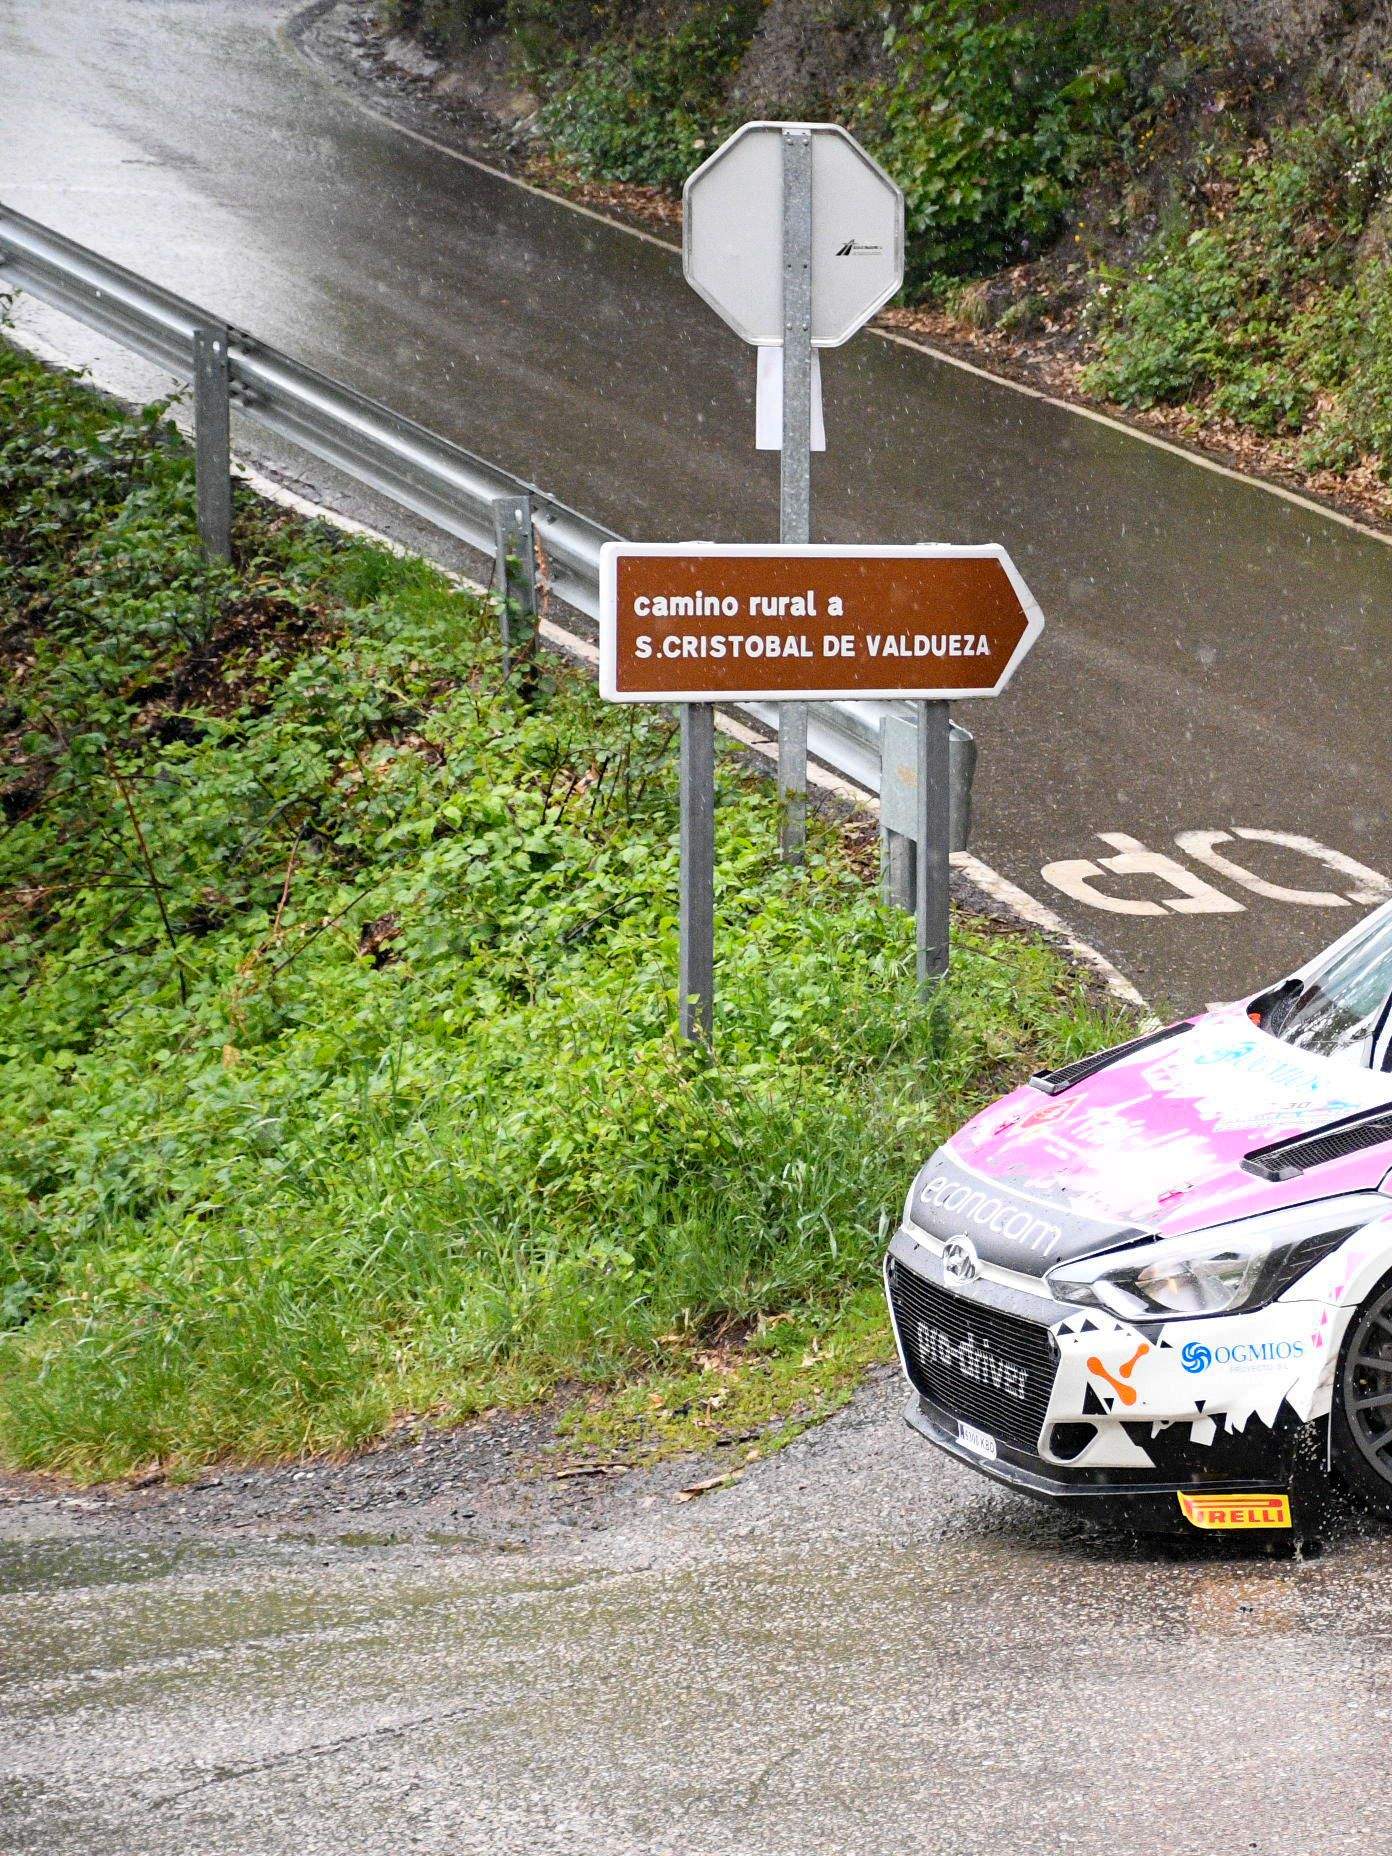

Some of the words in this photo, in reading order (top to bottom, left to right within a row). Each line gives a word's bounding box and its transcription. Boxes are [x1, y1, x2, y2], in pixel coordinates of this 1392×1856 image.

[633, 591, 739, 617] camino
[749, 590, 817, 617] rural
[827, 596, 844, 617] a
[634, 634, 814, 659] S.CRISTOBAL
[823, 635, 856, 658] DE
[866, 634, 991, 658] VALDUEZA
[920, 1176, 1062, 1258] econocom
[1214, 1340, 1304, 1364] OGMIOS
[1183, 1498, 1285, 1524] PIRELLI
